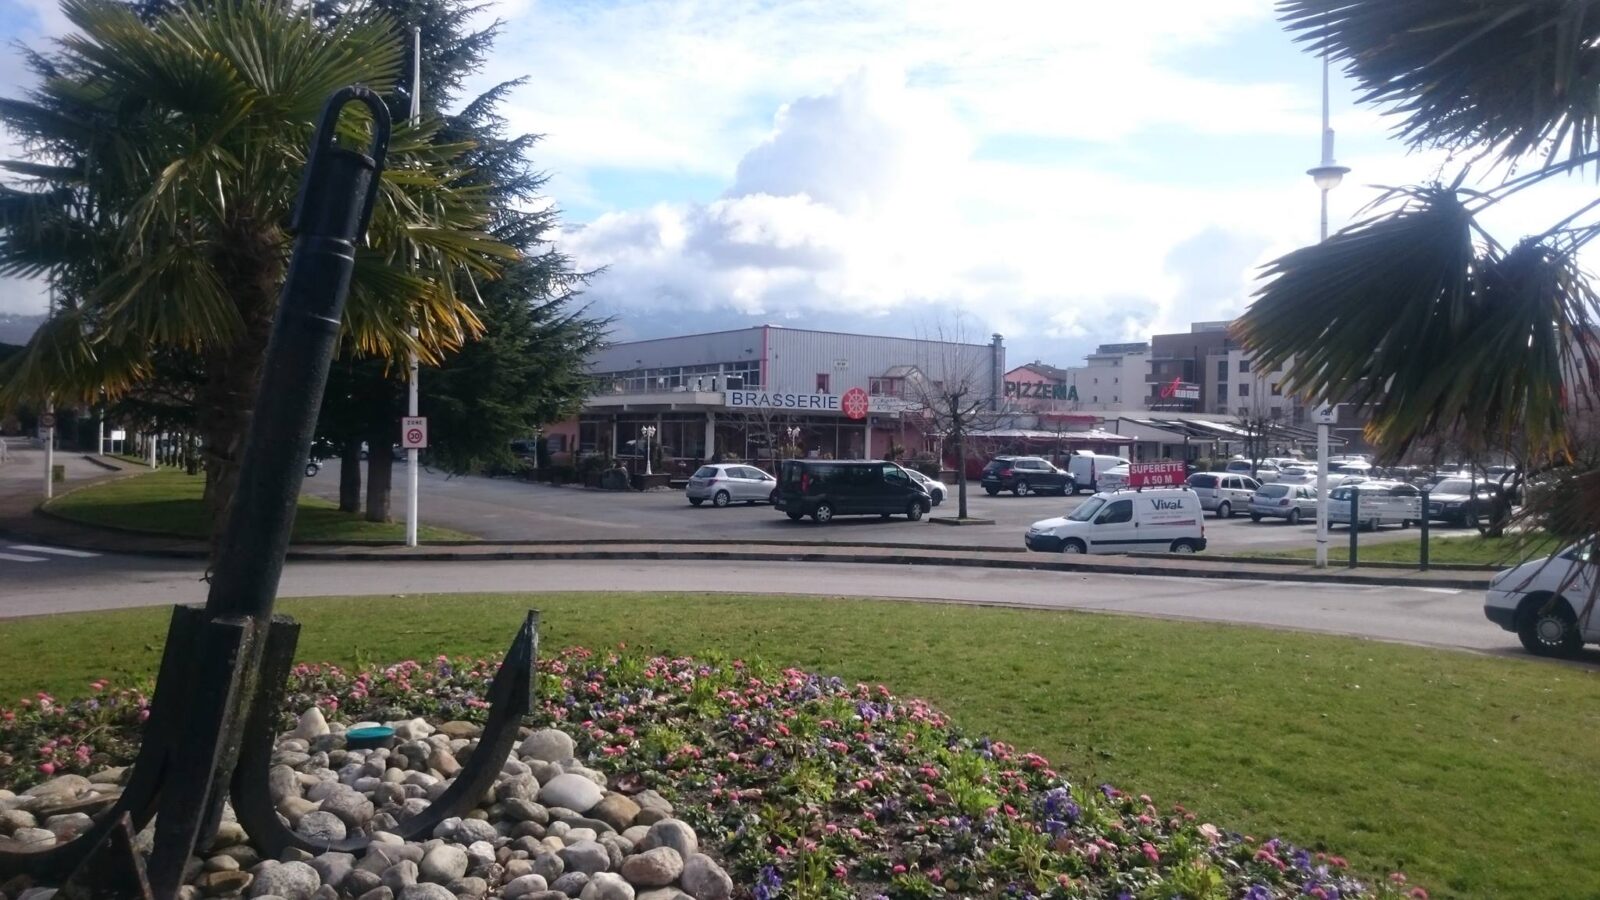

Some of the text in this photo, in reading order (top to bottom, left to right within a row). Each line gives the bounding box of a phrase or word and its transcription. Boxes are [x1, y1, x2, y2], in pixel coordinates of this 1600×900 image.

[732, 391, 838, 409] BRASSERIE
[1130, 463, 1183, 474] SUPERETTE
[1143, 475, 1172, 484] A 50 M
